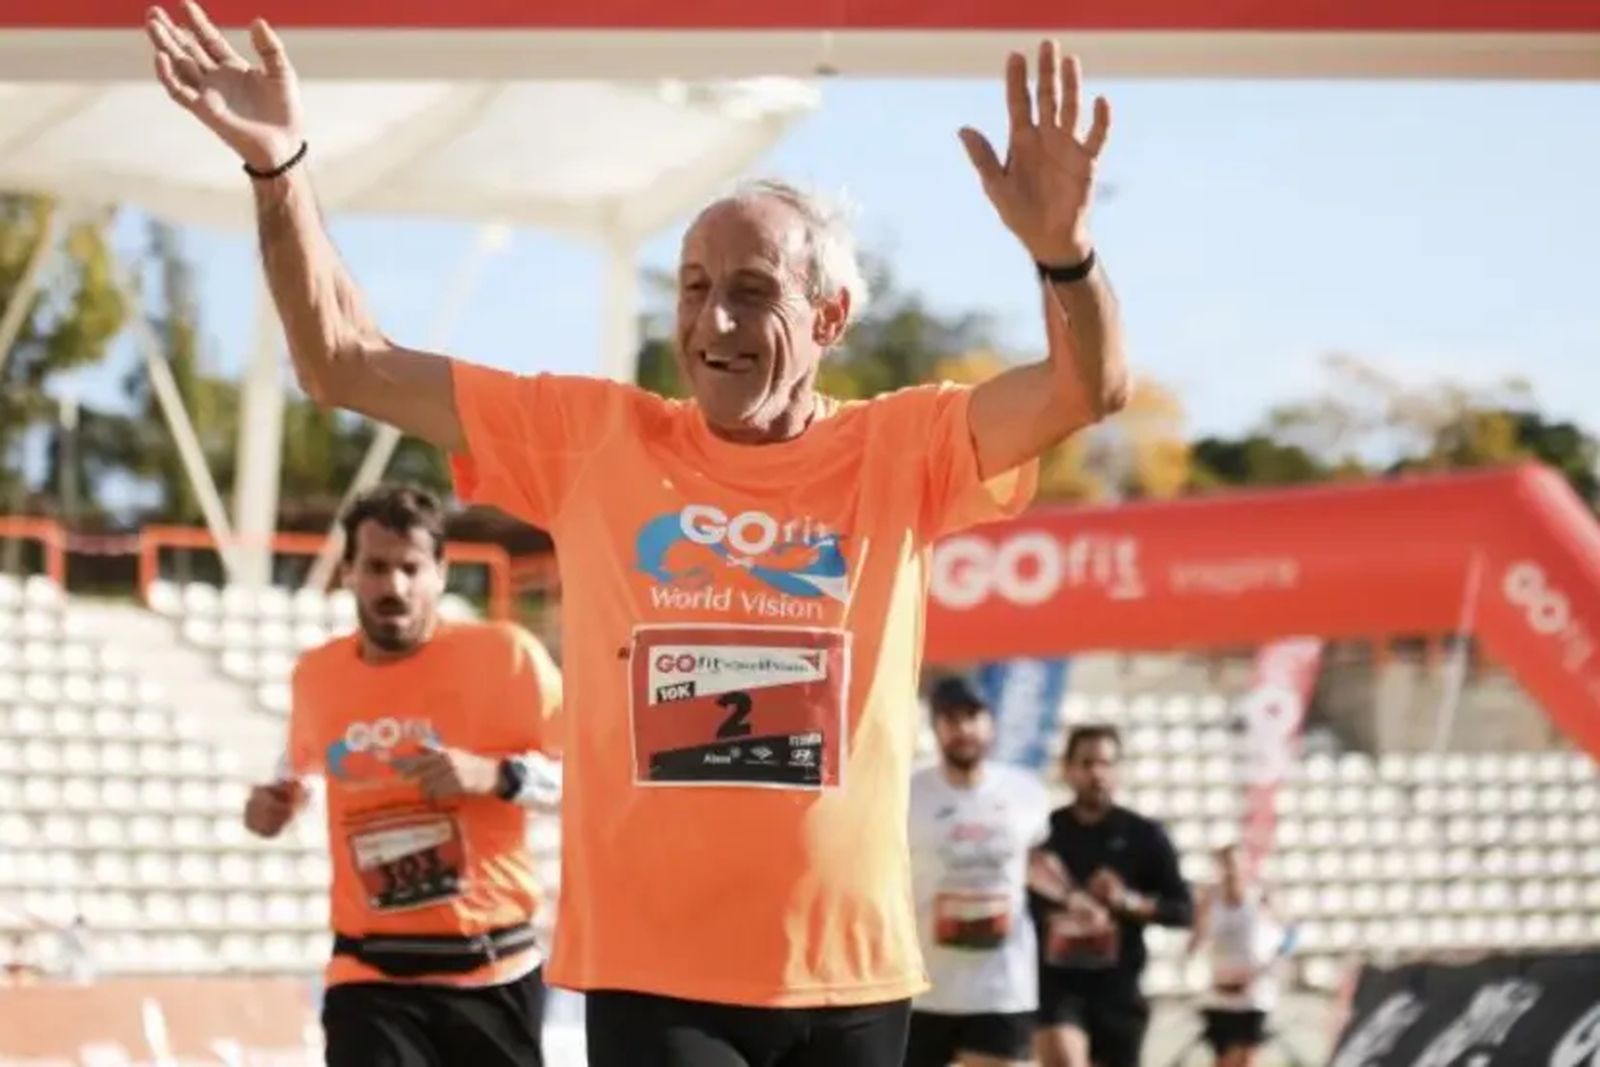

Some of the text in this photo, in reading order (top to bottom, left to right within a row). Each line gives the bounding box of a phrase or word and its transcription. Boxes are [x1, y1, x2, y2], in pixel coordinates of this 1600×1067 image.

[650, 586, 823, 621] World Vision
[660, 683, 693, 702] 10K
[716, 690, 753, 739] 2
